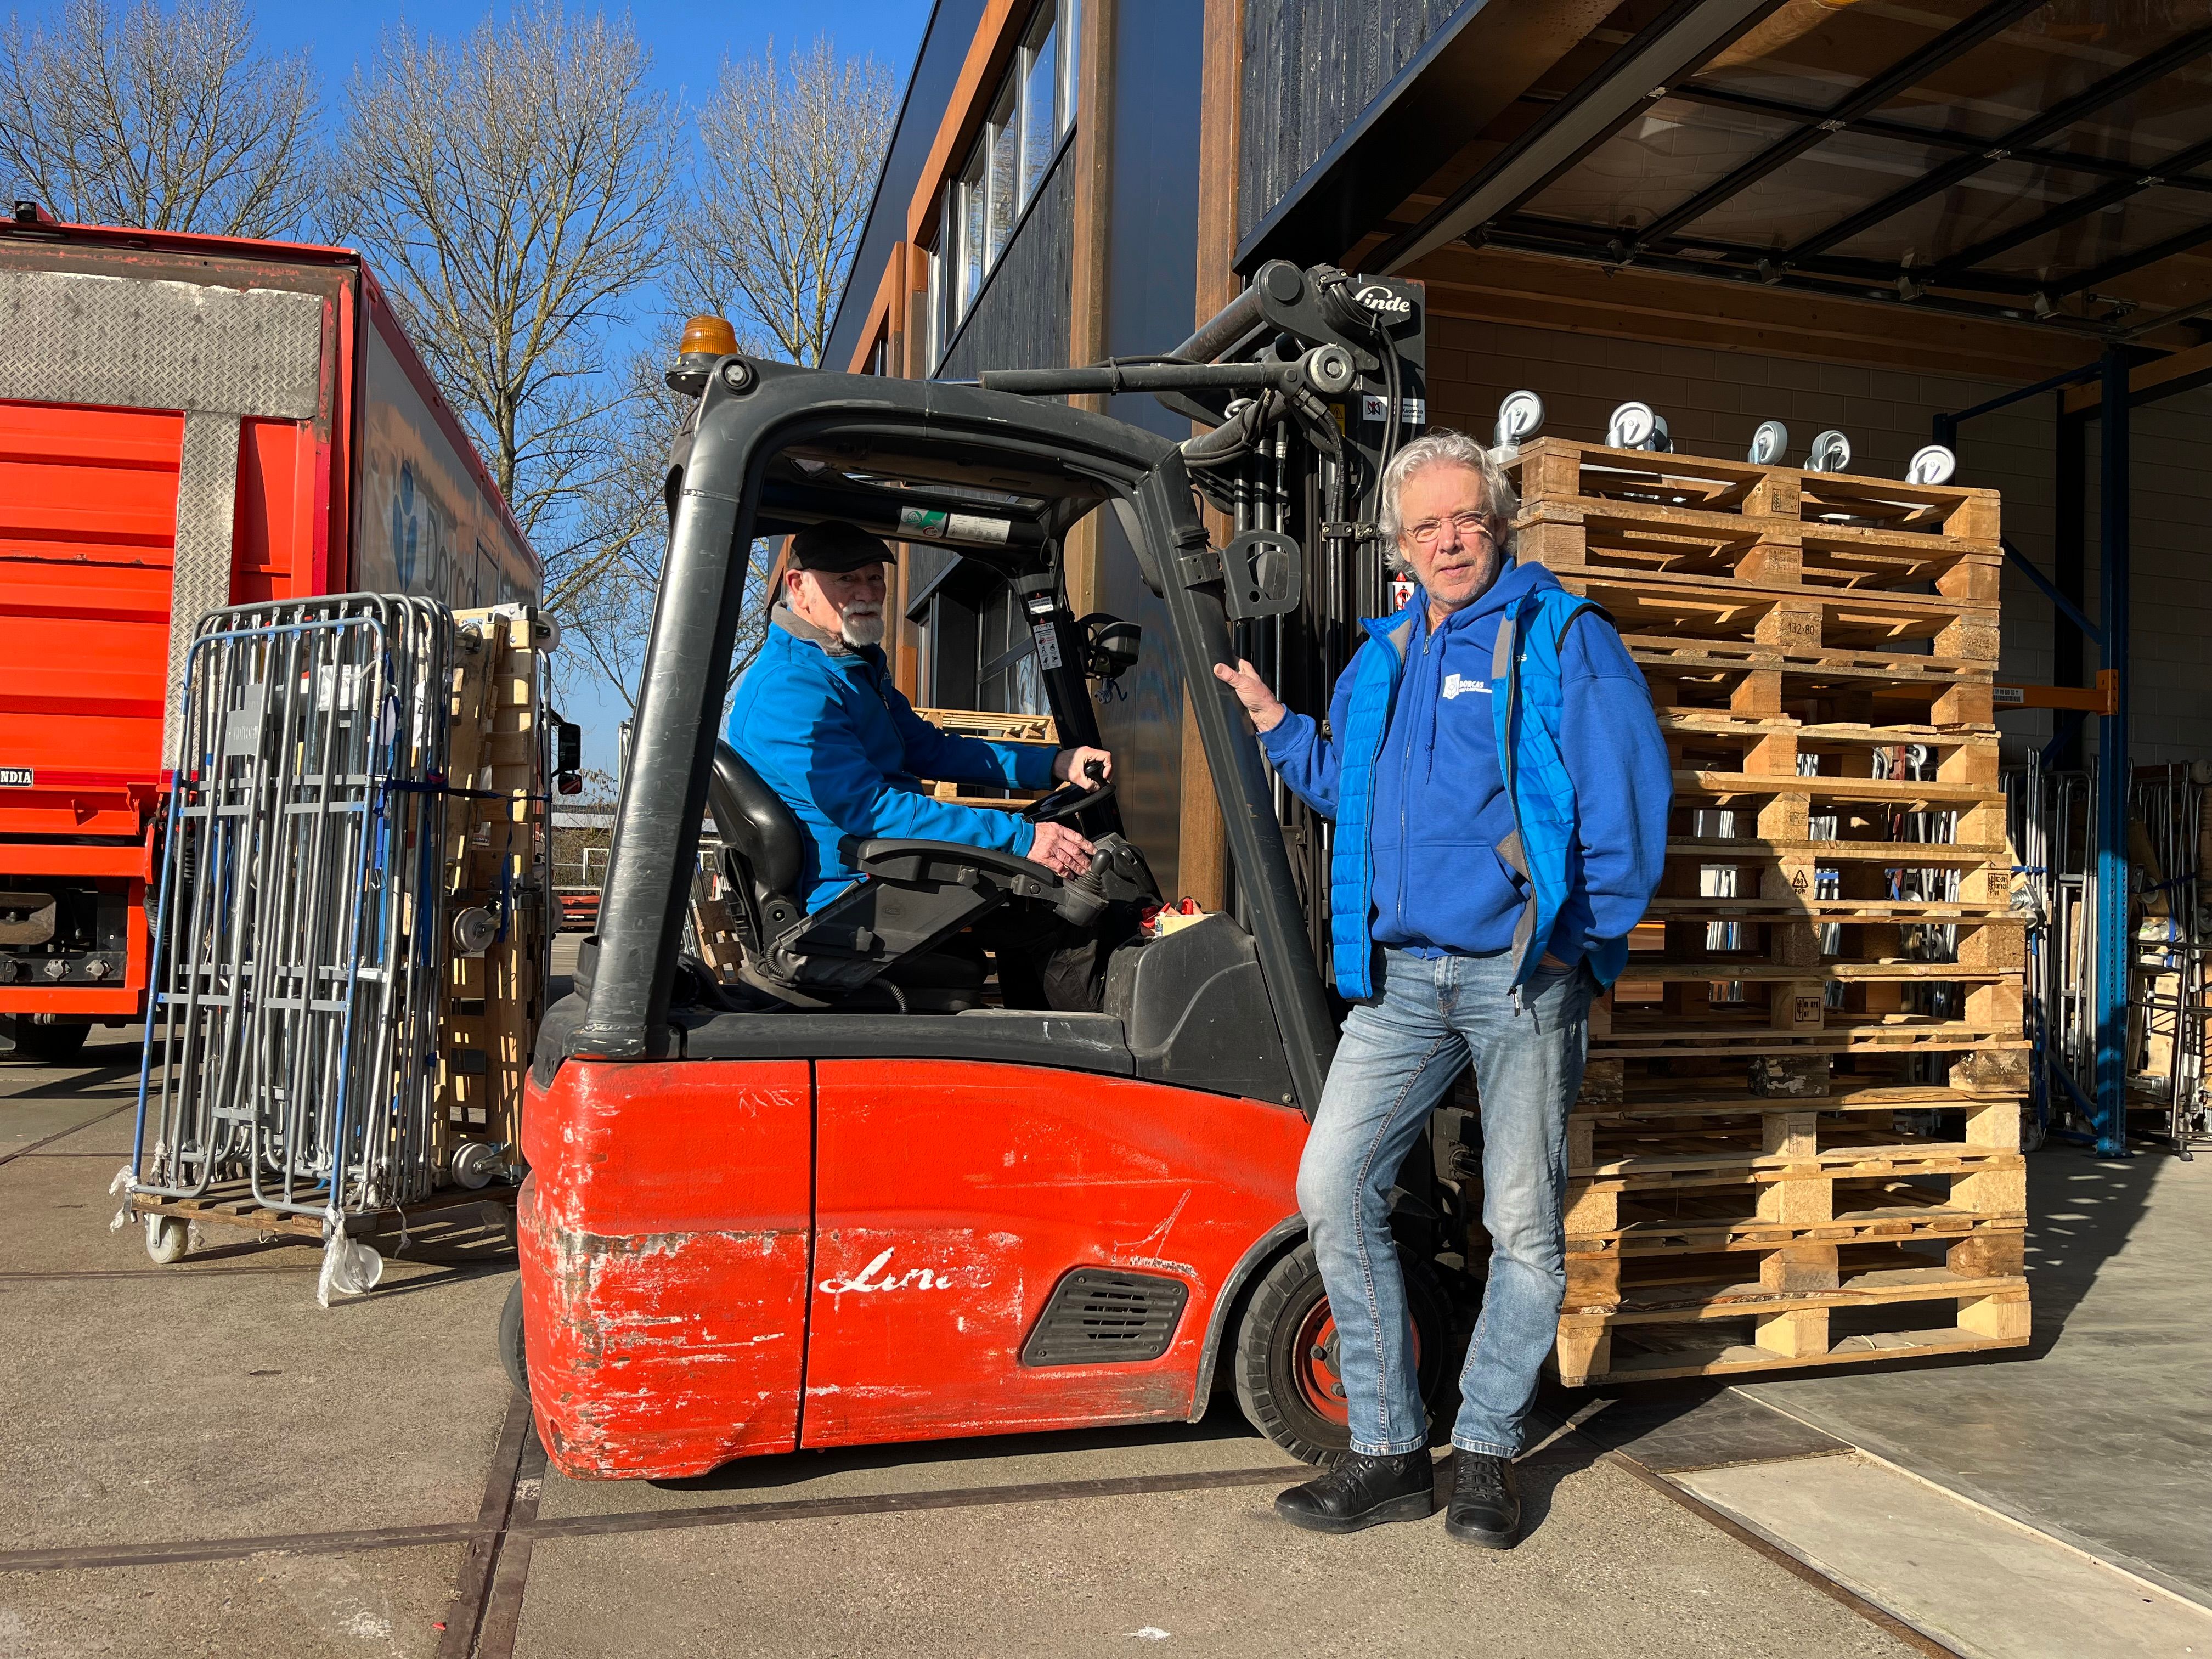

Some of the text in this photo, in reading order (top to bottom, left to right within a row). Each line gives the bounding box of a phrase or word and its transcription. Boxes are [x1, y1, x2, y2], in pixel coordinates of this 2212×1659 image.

[1459, 680, 1484, 689] DORCAS
[0, 771, 31, 783] NDIA
[819, 1246, 992, 1294] Lin
